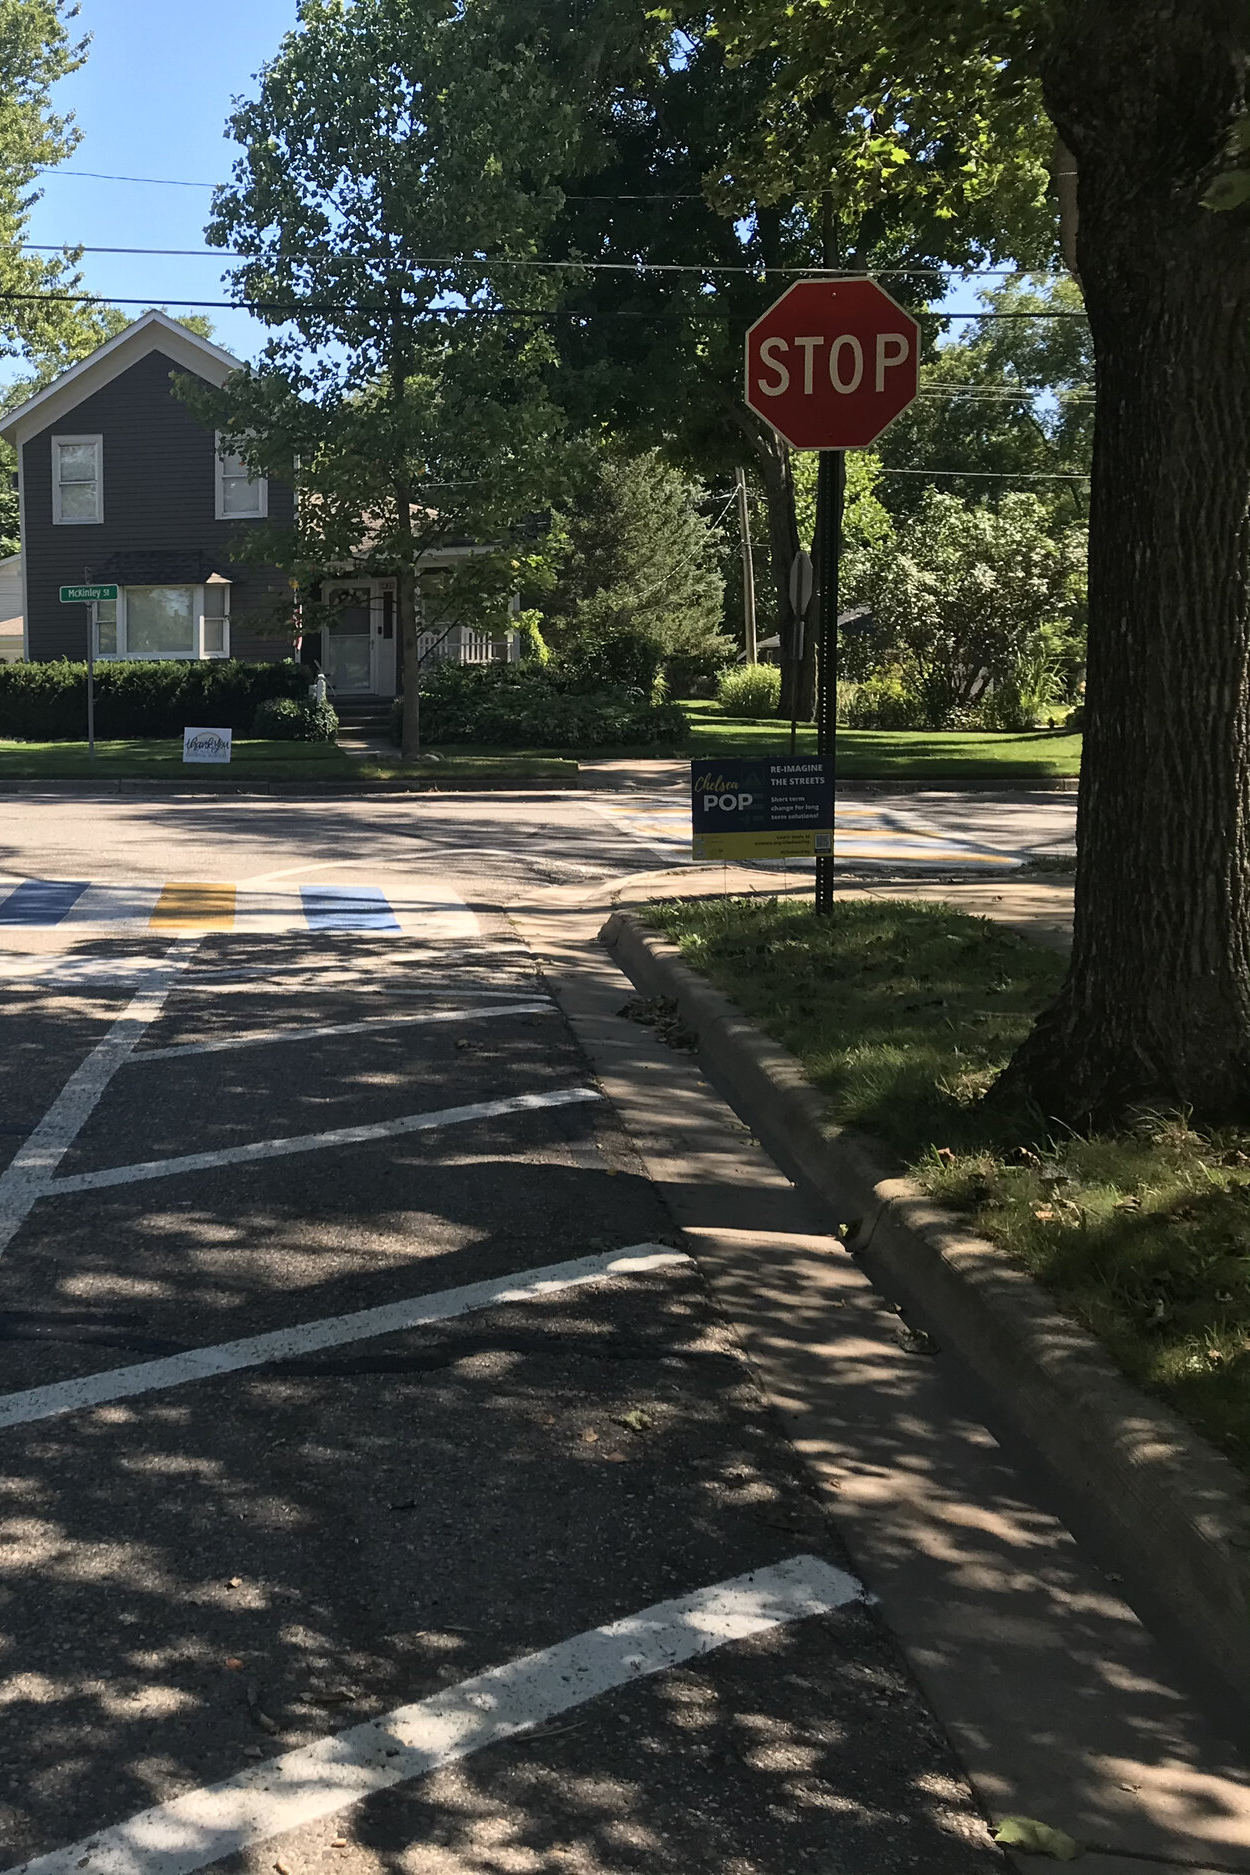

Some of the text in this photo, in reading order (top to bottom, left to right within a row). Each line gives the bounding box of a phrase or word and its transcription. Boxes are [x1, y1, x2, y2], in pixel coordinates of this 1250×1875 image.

[758, 333, 909, 396] STOP
[68, 588, 100, 598] McKinley
[770, 764, 823, 773] RE-IMAGINE
[694, 772, 740, 792] Chelsea
[770, 776, 826, 786] THE STREETS
[703, 793, 753, 812] POP
